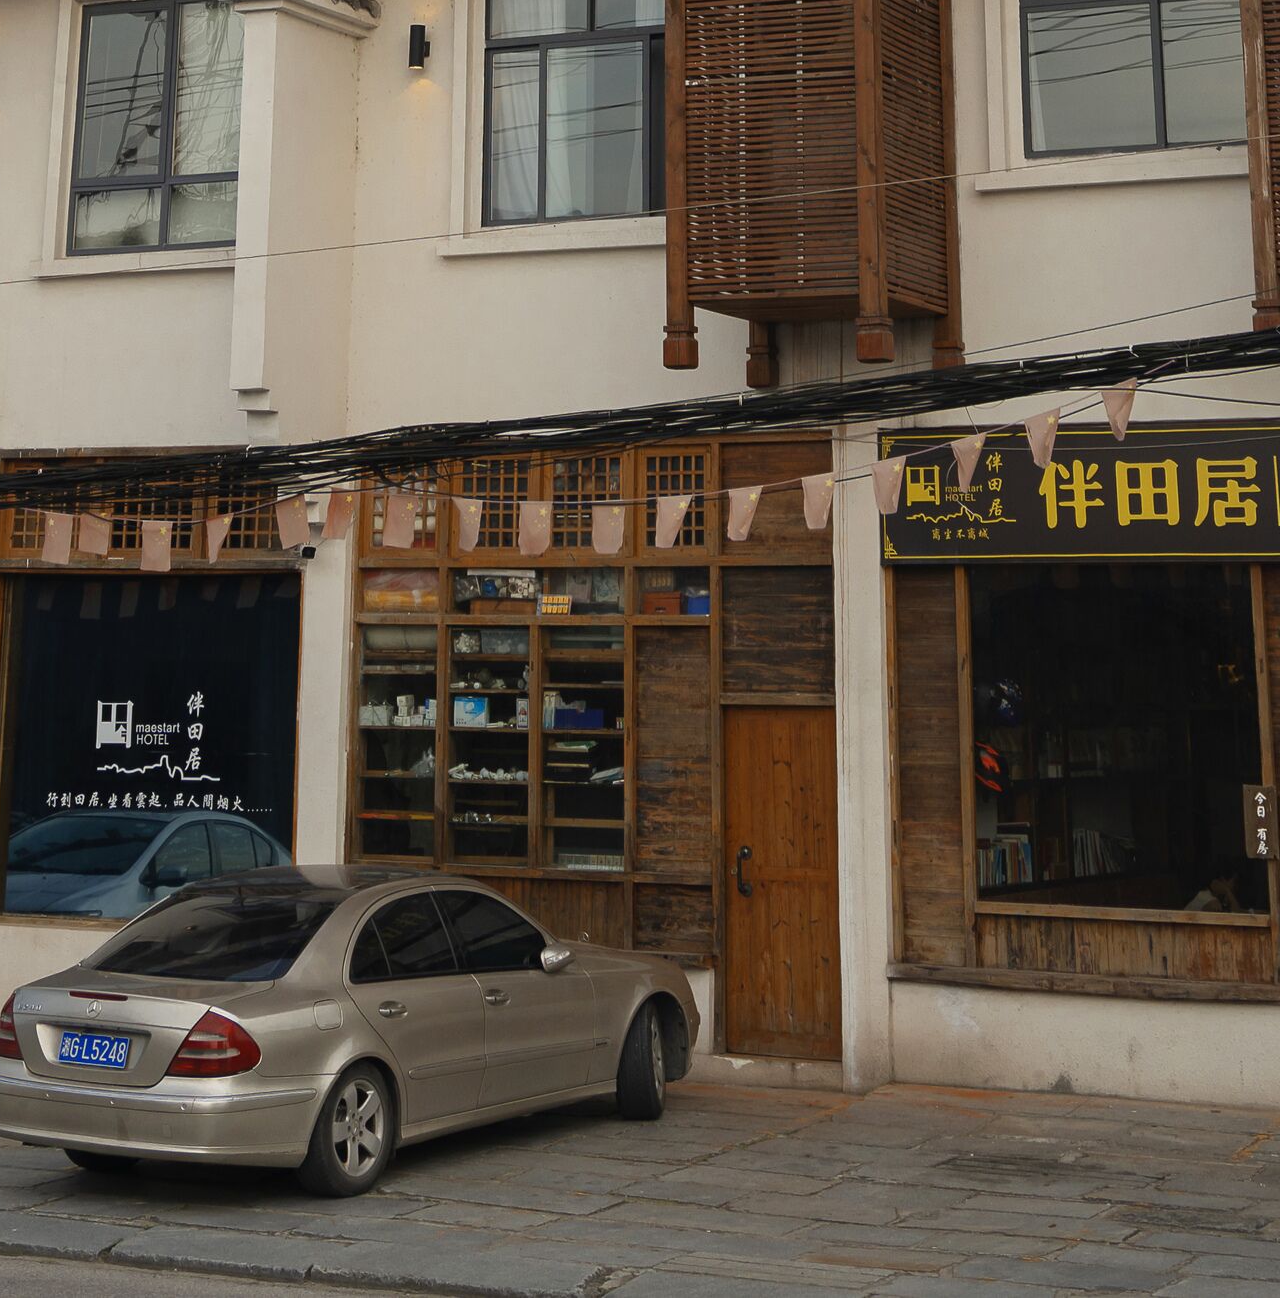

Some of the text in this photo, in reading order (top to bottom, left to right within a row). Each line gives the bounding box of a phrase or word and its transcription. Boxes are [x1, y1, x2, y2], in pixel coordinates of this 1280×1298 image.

[945, 493, 976, 502] HOTEL
[986, 452, 1003, 517] 伴田居
[1039, 456, 1261, 529] 伴田居
[135, 722, 180, 734] maestart
[136, 734, 169, 745] HOTEL
[185, 691, 205, 771] 伴田居
[1254, 792, 1269, 855] 今日 有房
